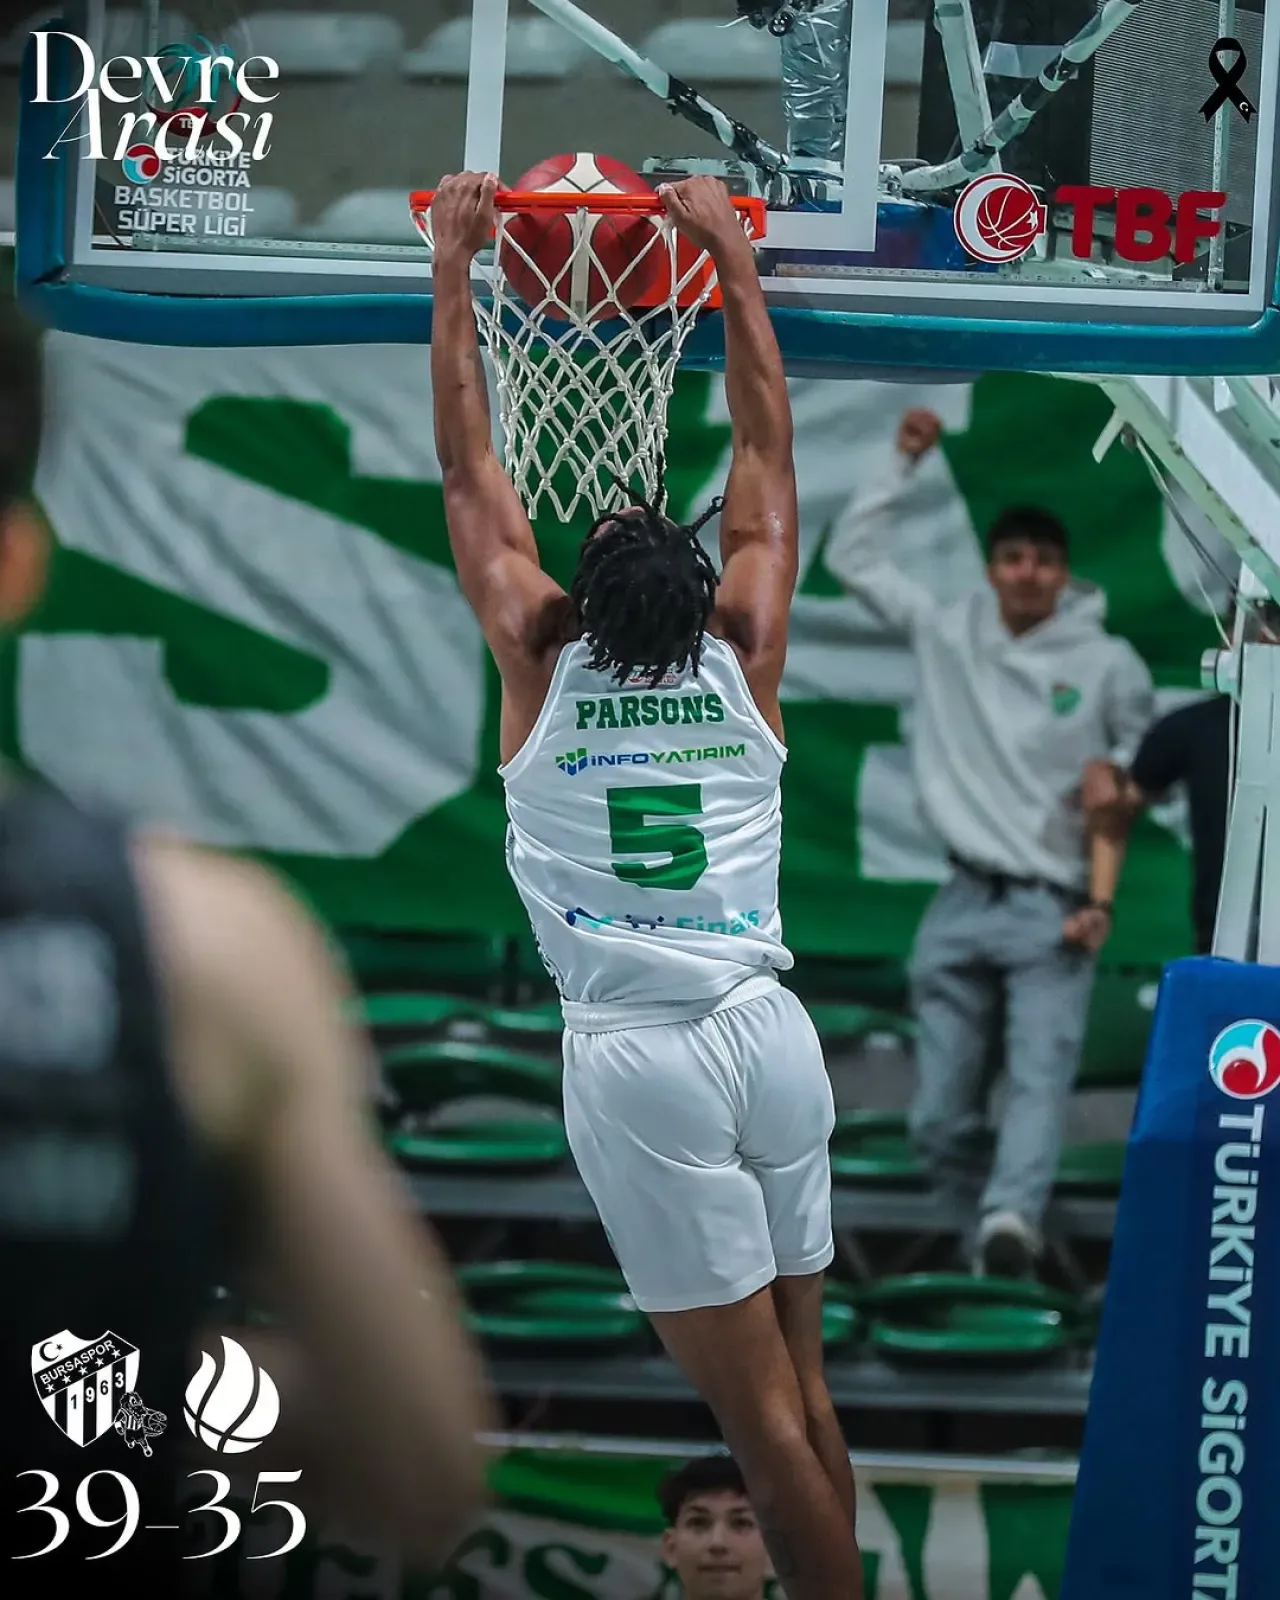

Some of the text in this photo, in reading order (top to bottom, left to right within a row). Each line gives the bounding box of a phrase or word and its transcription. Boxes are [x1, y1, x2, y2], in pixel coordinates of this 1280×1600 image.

[114, 185, 255, 212] BASKETBOL
[117, 208, 247, 237] SÜPER LİGİ
[1055, 184, 1227, 263] TBF
[575, 693, 725, 730] PARSONS
[606, 783, 709, 891] 5
[1192, 1376, 1248, 1600] SİGORT
